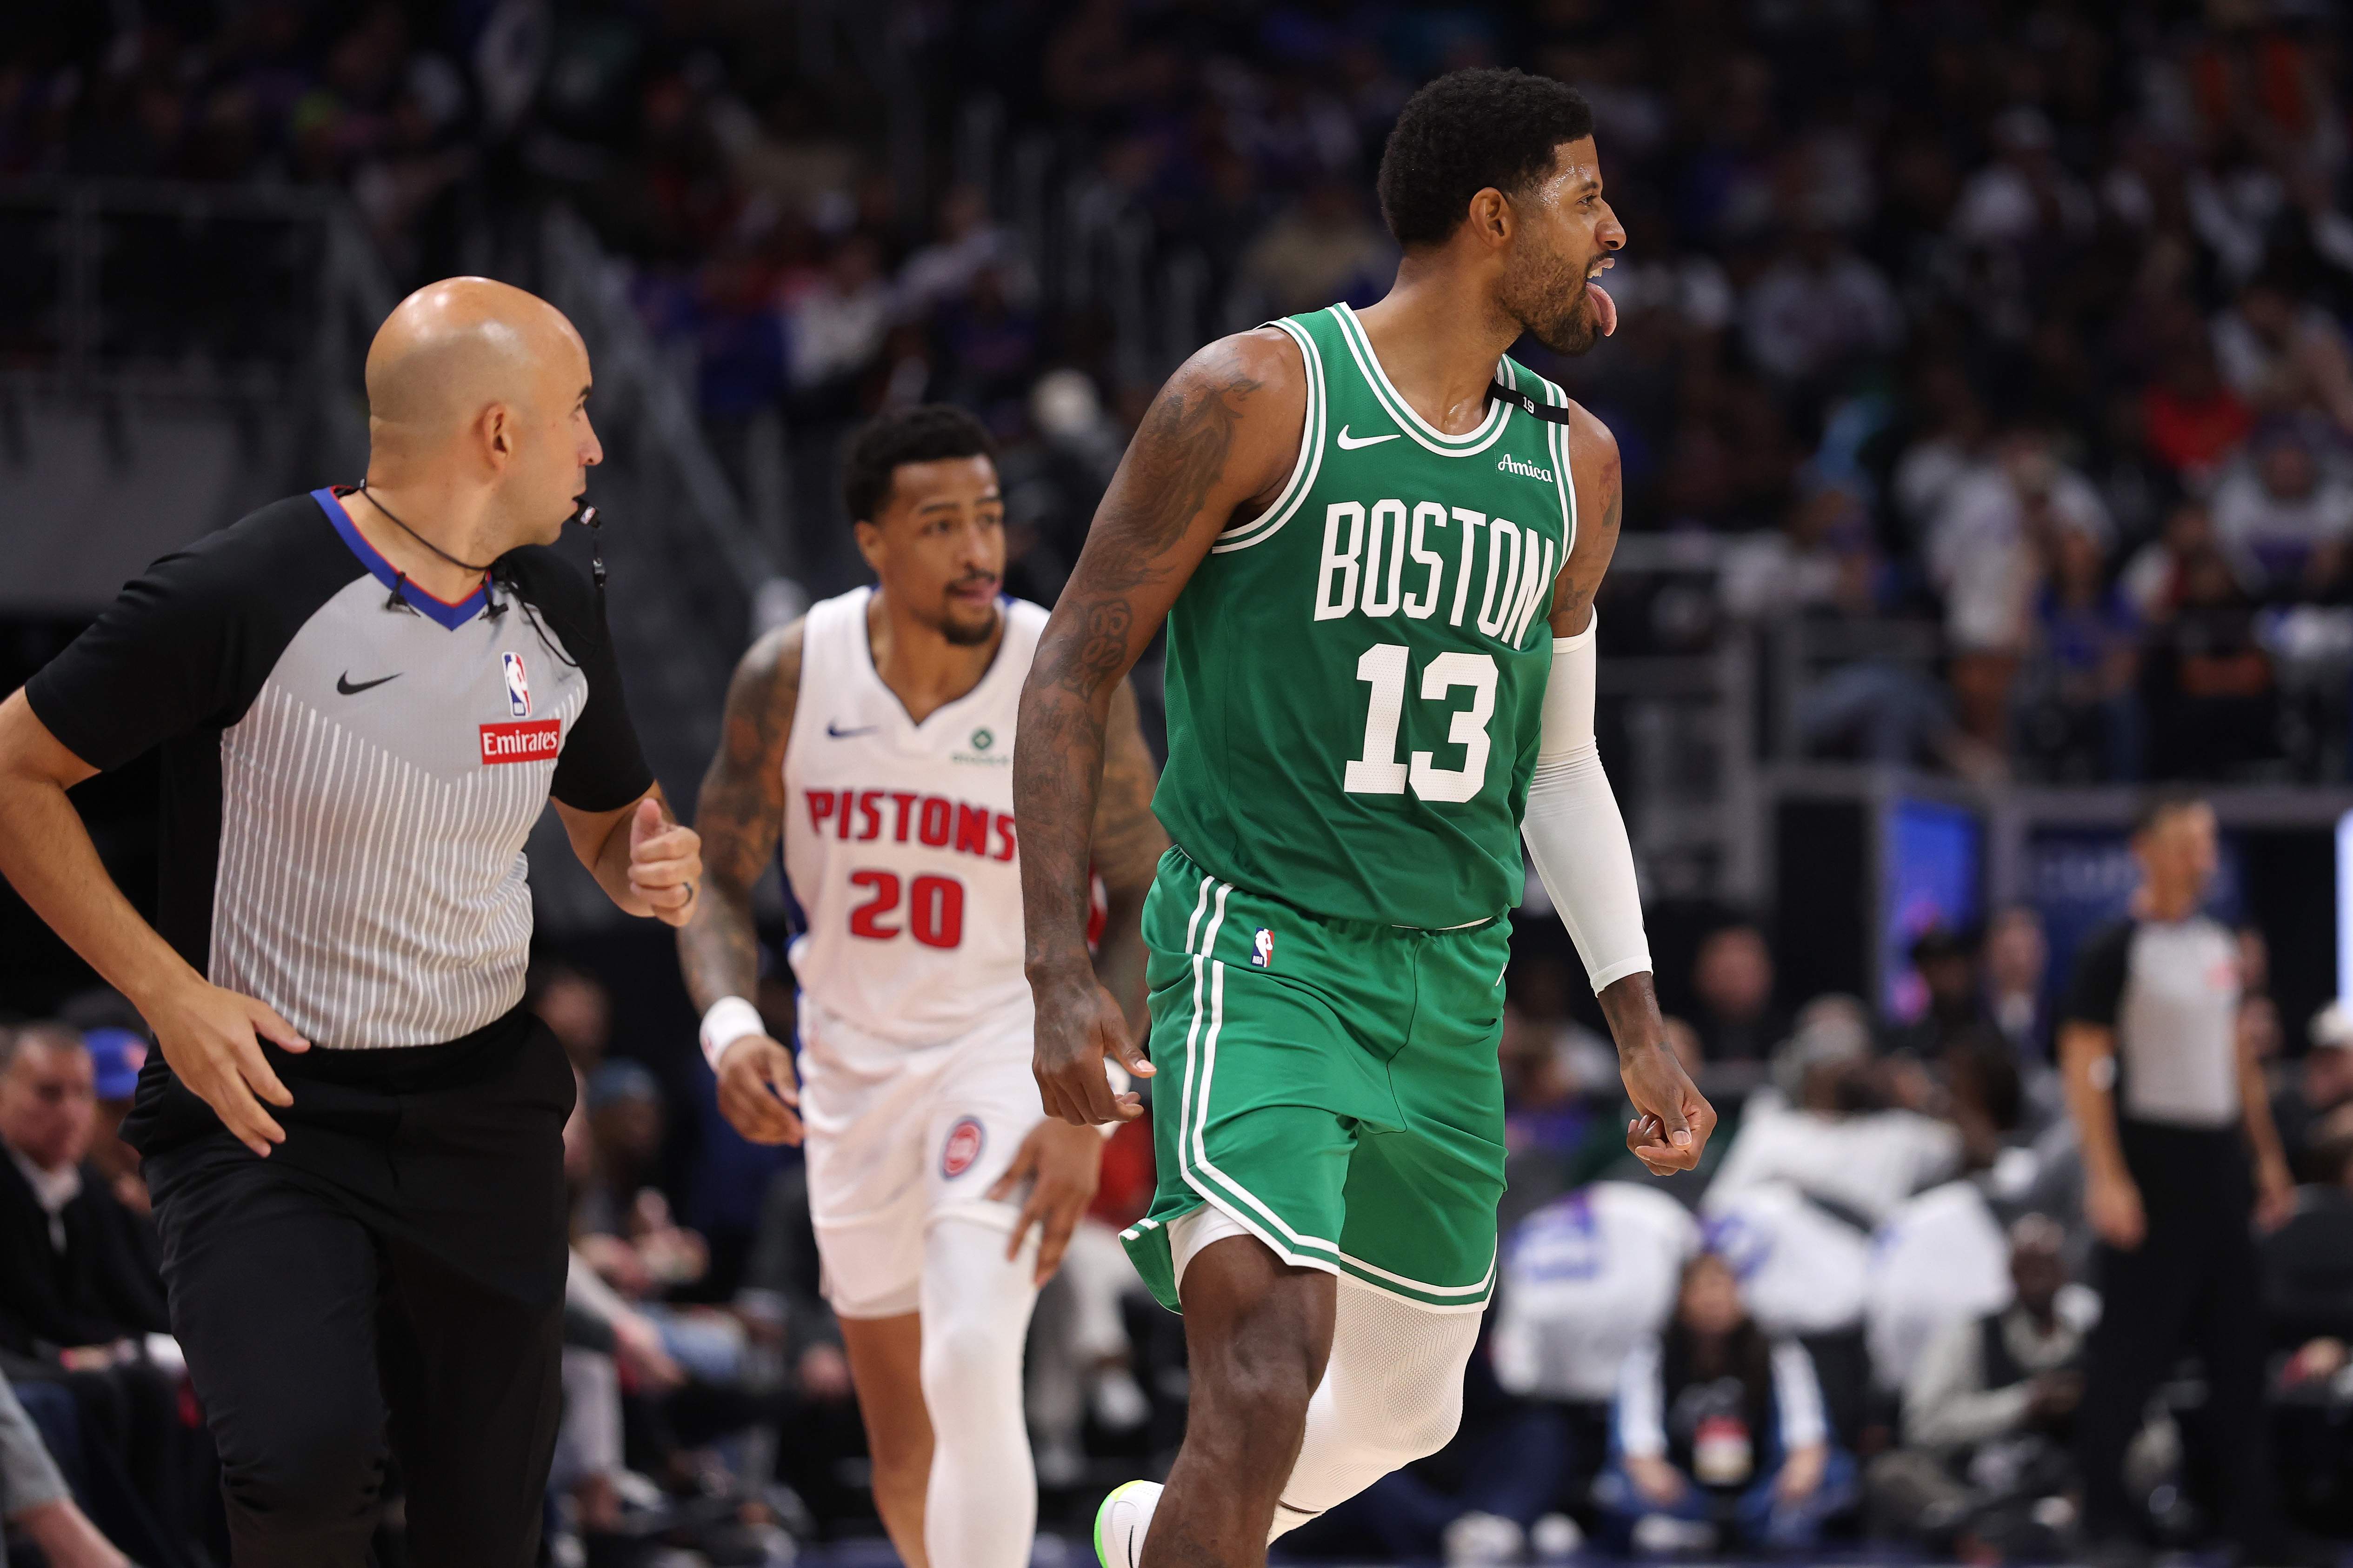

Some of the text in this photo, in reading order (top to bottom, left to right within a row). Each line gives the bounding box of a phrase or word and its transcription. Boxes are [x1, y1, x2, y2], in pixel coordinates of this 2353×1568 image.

[1523, 396, 1534, 414] 19
[1498, 453, 1553, 483] Amica
[1313, 499, 1554, 651] BOSTON
[482, 729, 558, 756] Emirates
[1344, 643, 1499, 803] 13
[805, 790, 1016, 863] PISTONS
[850, 870, 964, 950] 20
[1252, 955, 1263, 965] NBA
